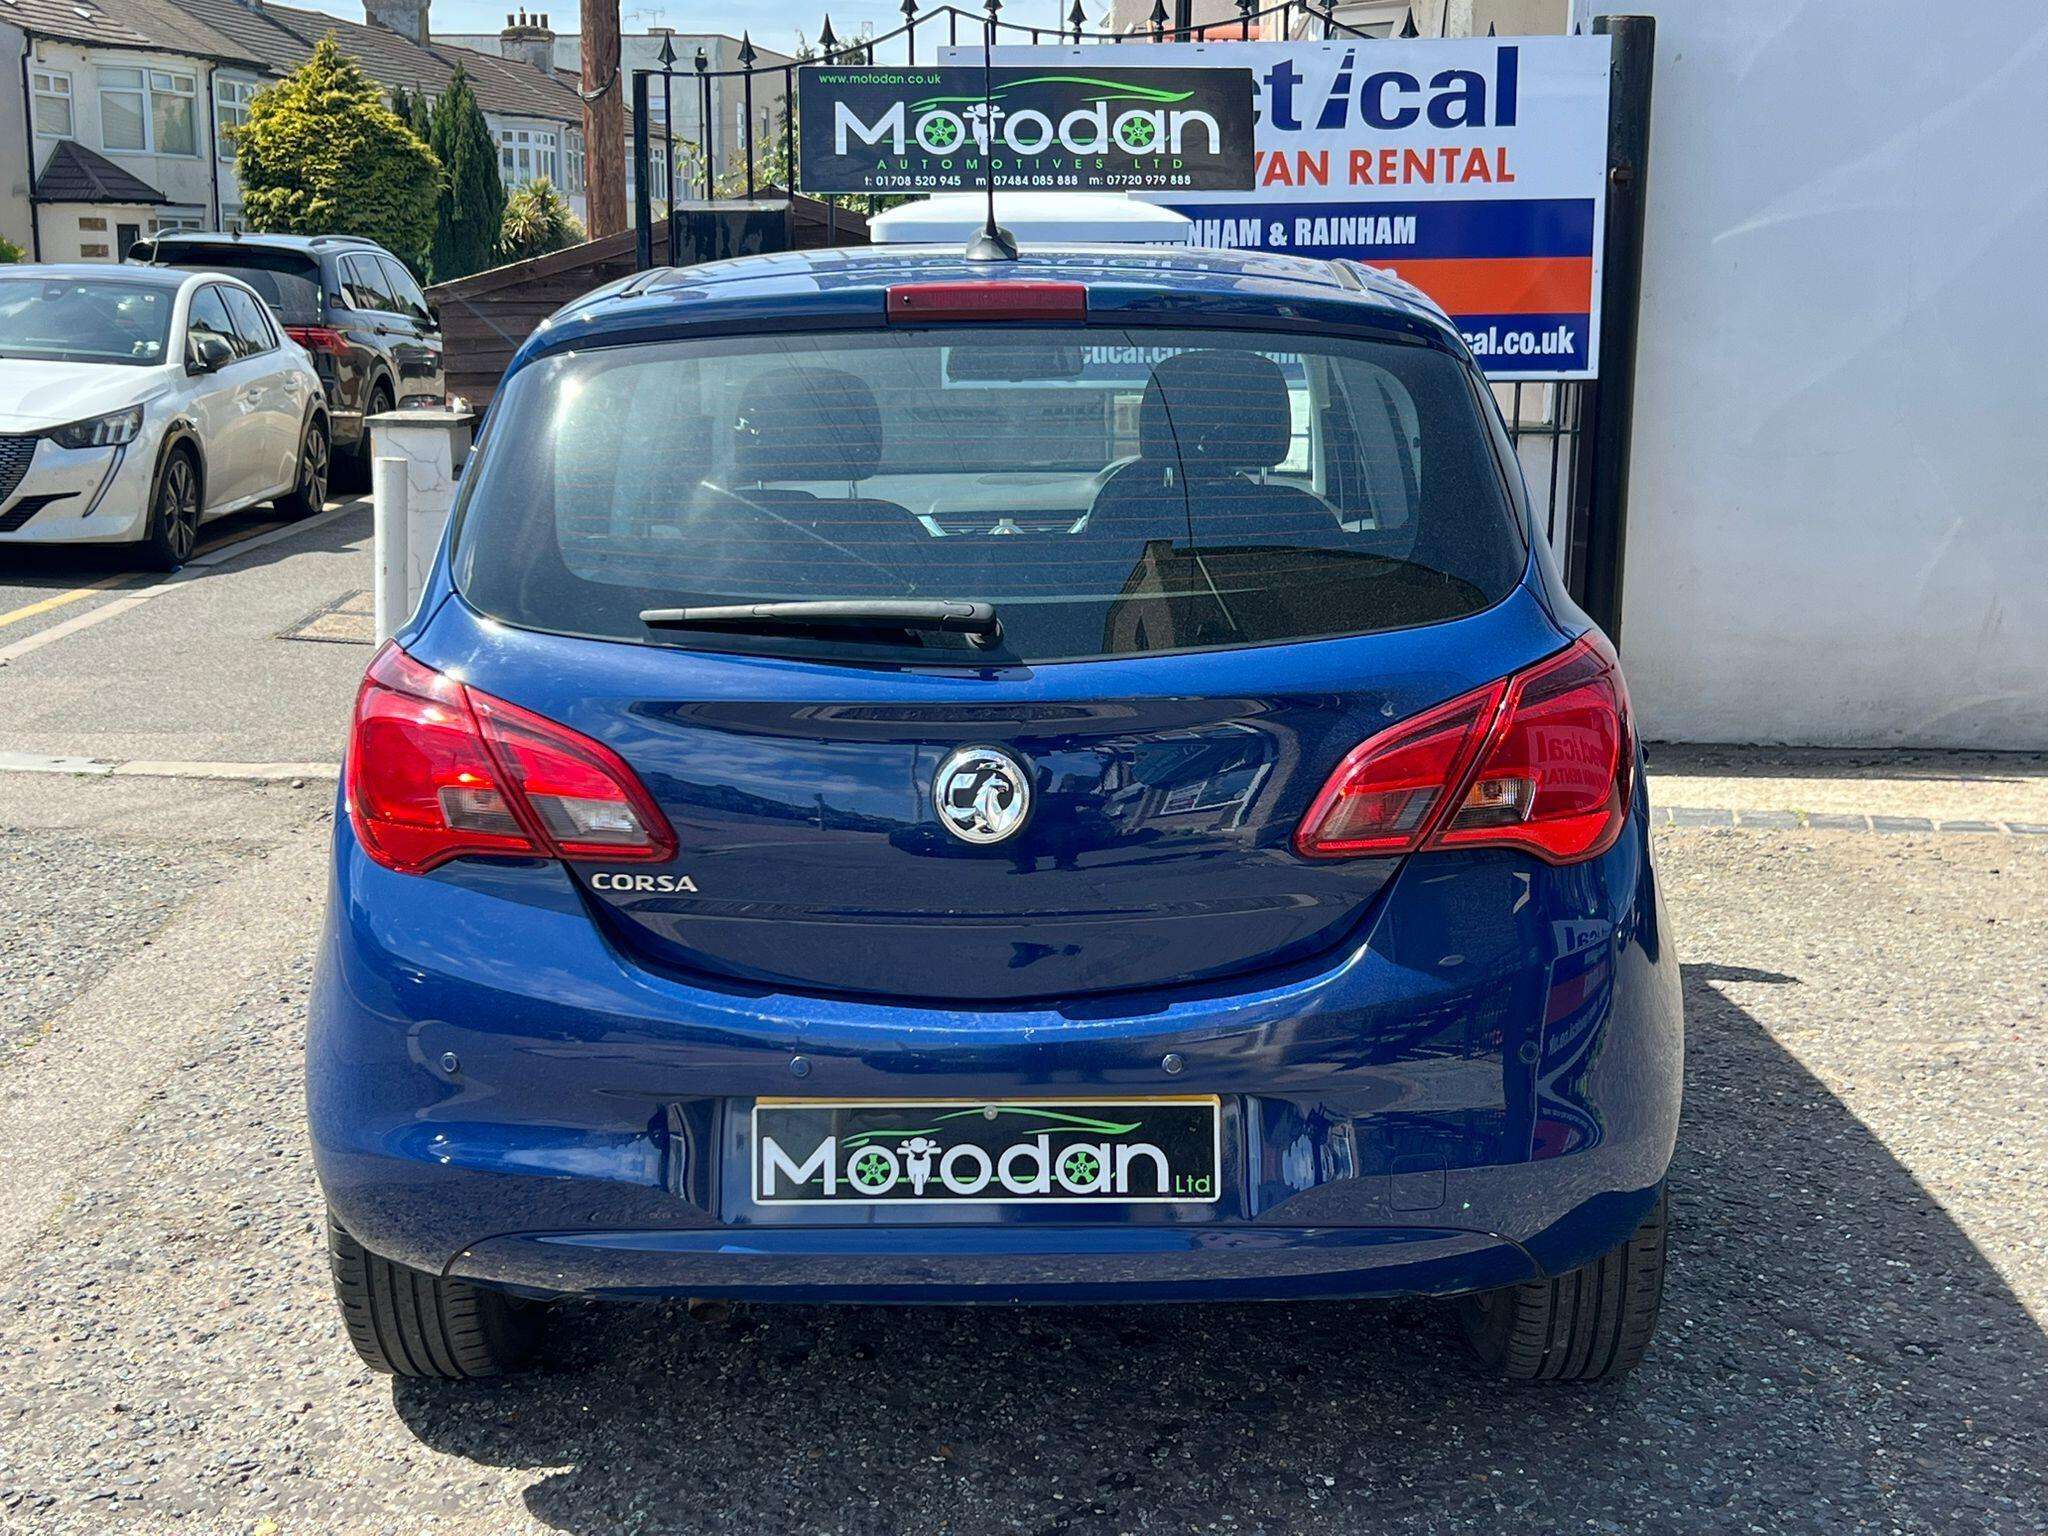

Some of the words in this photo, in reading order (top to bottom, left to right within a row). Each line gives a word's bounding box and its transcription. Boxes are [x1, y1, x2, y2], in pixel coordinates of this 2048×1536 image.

[819, 73, 941, 84] www.motodan.co.uk
[1252, 46, 1519, 132] tical
[834, 101, 1220, 156] Motodan
[877, 159, 1103, 169] AUTOMOTIVES
[1134, 159, 1183, 169] LTD
[1348, 147, 1516, 186] RENTAL
[864, 176, 872, 186] t:
[875, 176, 911, 186] 01708
[914, 176, 936, 186] 520
[939, 176, 961, 186] 945
[993, 175, 1029, 186] 07484
[1032, 175, 1053, 186] 085
[1057, 175, 1078, 186] 888
[1089, 176, 1103, 186] m:
[1106, 175, 1142, 186] 07720
[1145, 175, 1166, 186] 979
[1170, 175, 1191, 185] 888
[1144, 219, 1261, 248] NHAM
[1269, 223, 1288, 246] &
[1295, 217, 1416, 246] RAINHAM
[591, 873, 698, 892] CORSA
[762, 1133, 1170, 1195] Motodan
[1176, 1174, 1211, 1194] Ltd
